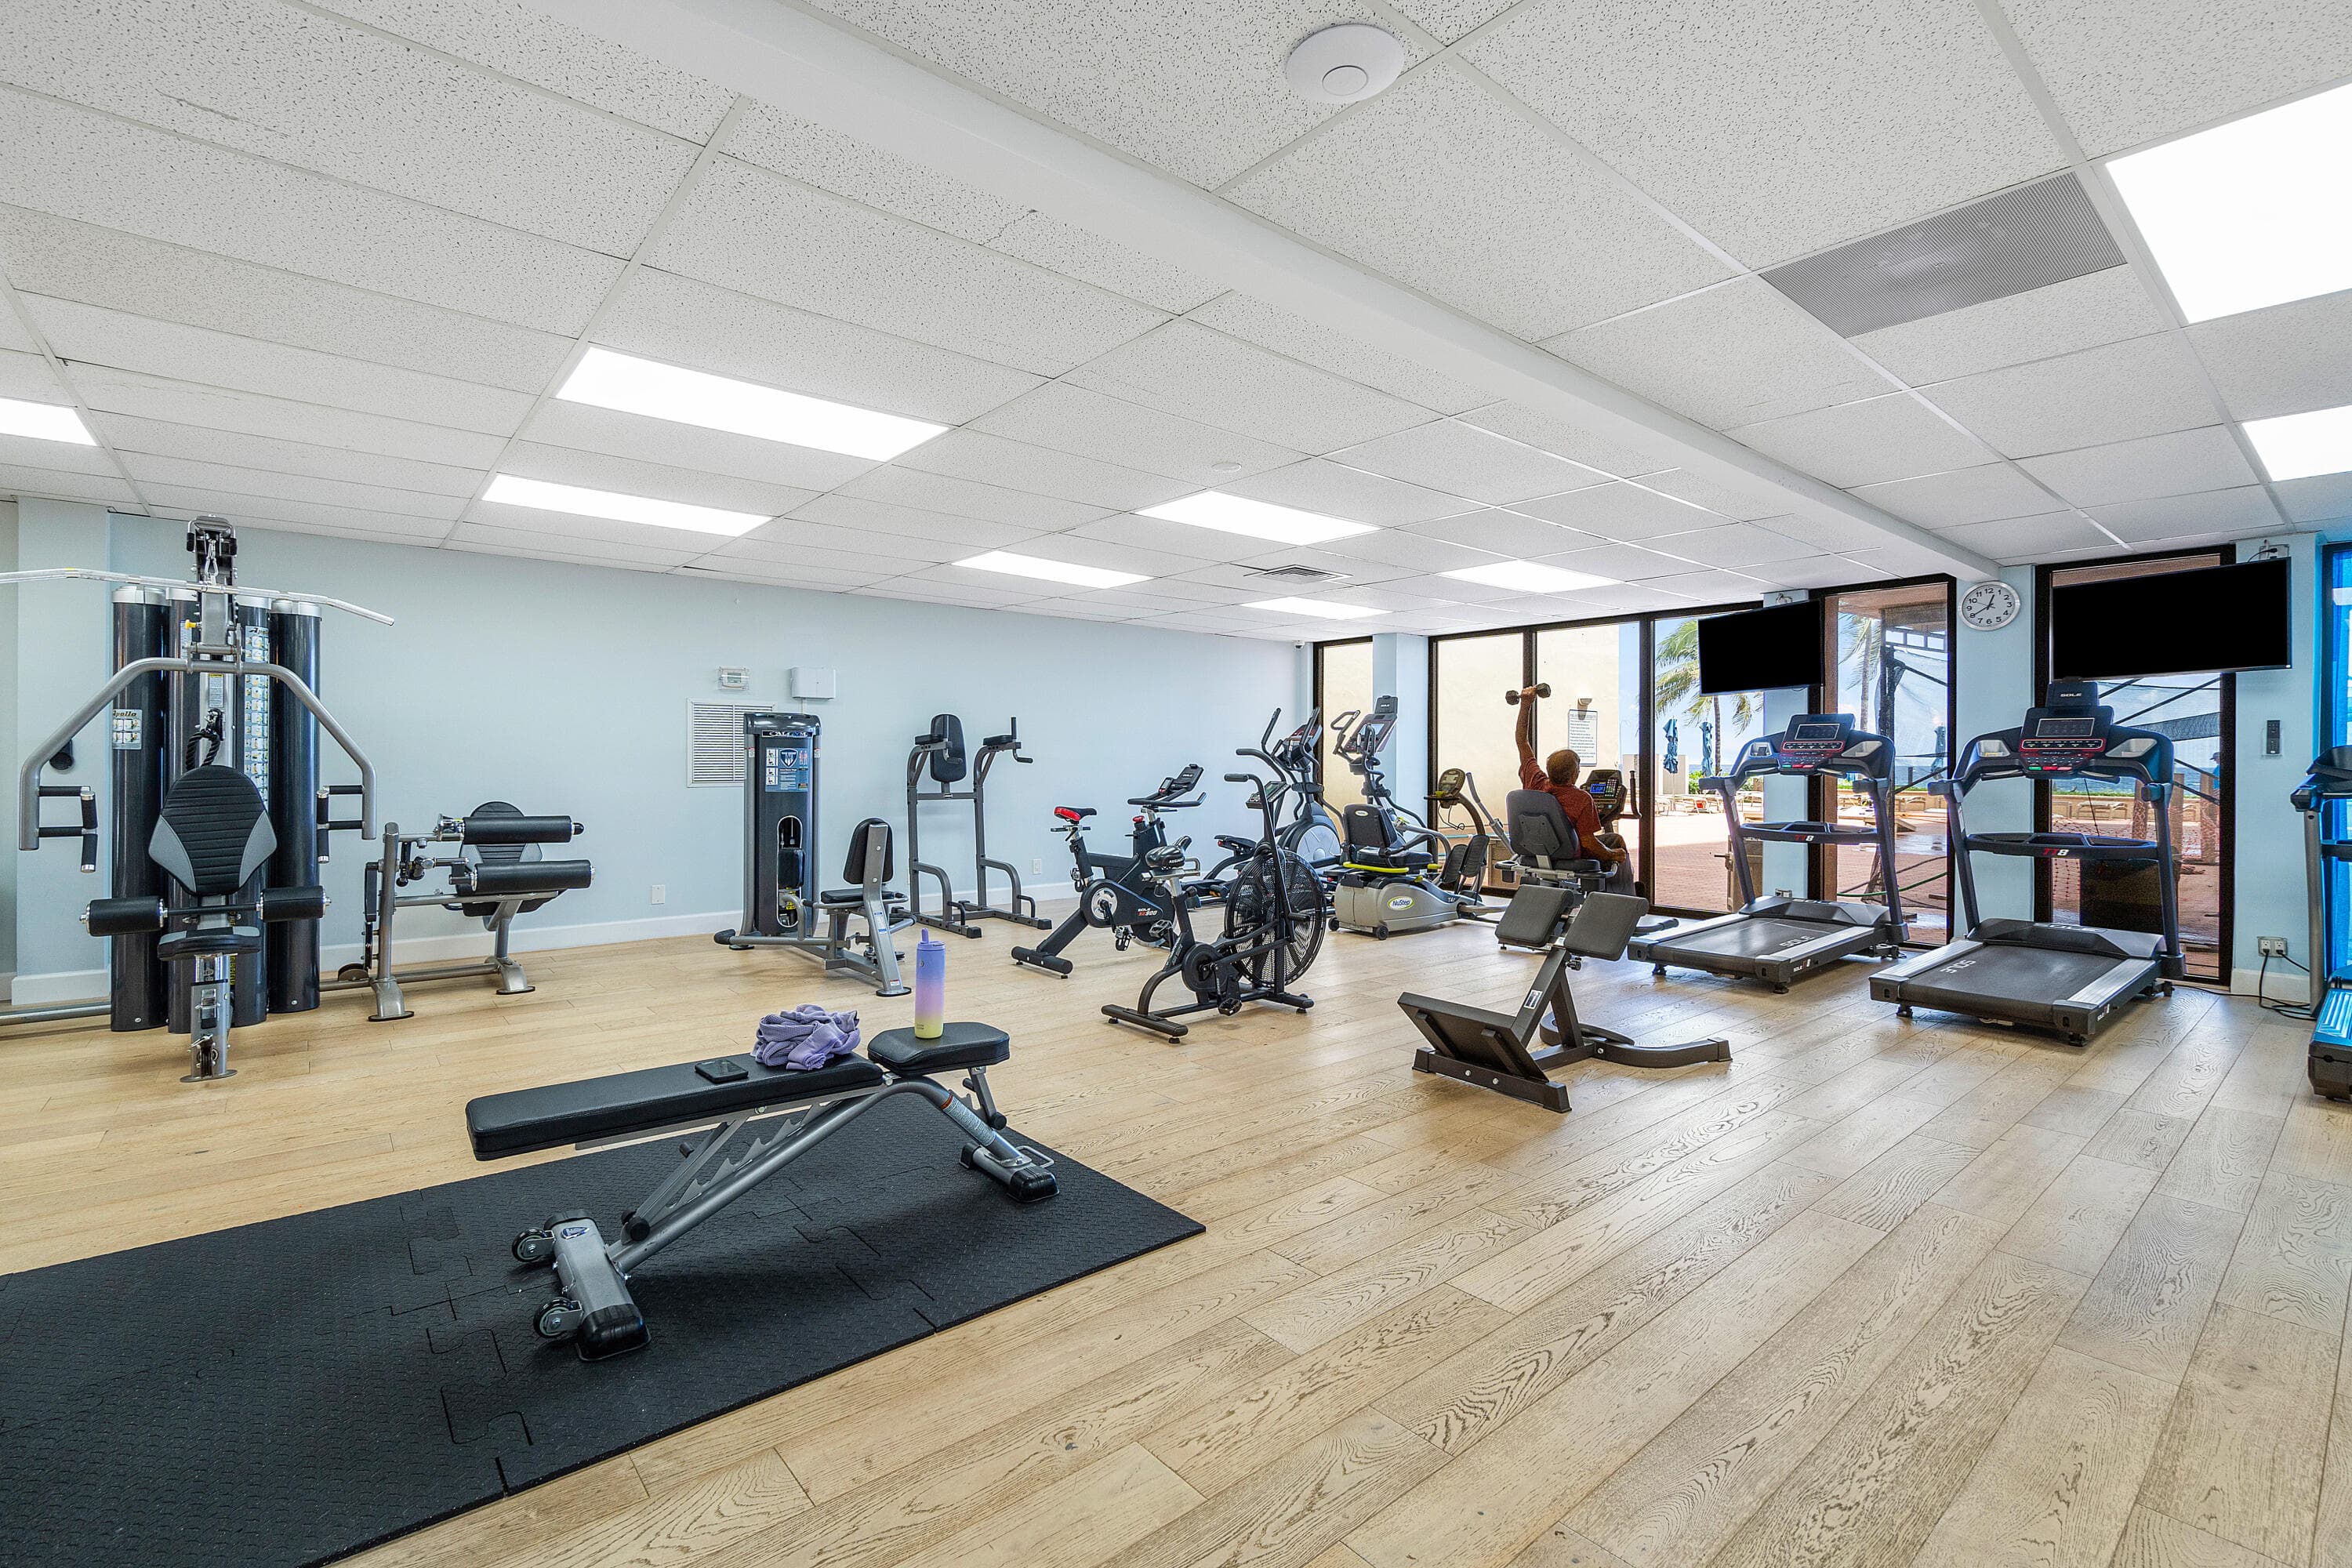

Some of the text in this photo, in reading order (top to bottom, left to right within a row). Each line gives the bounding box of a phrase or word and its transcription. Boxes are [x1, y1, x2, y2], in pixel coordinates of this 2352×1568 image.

[2043, 848, 2070, 856] TT8
[1779, 935, 1816, 946] SOLE
[1940, 960, 1976, 974] SOLE
